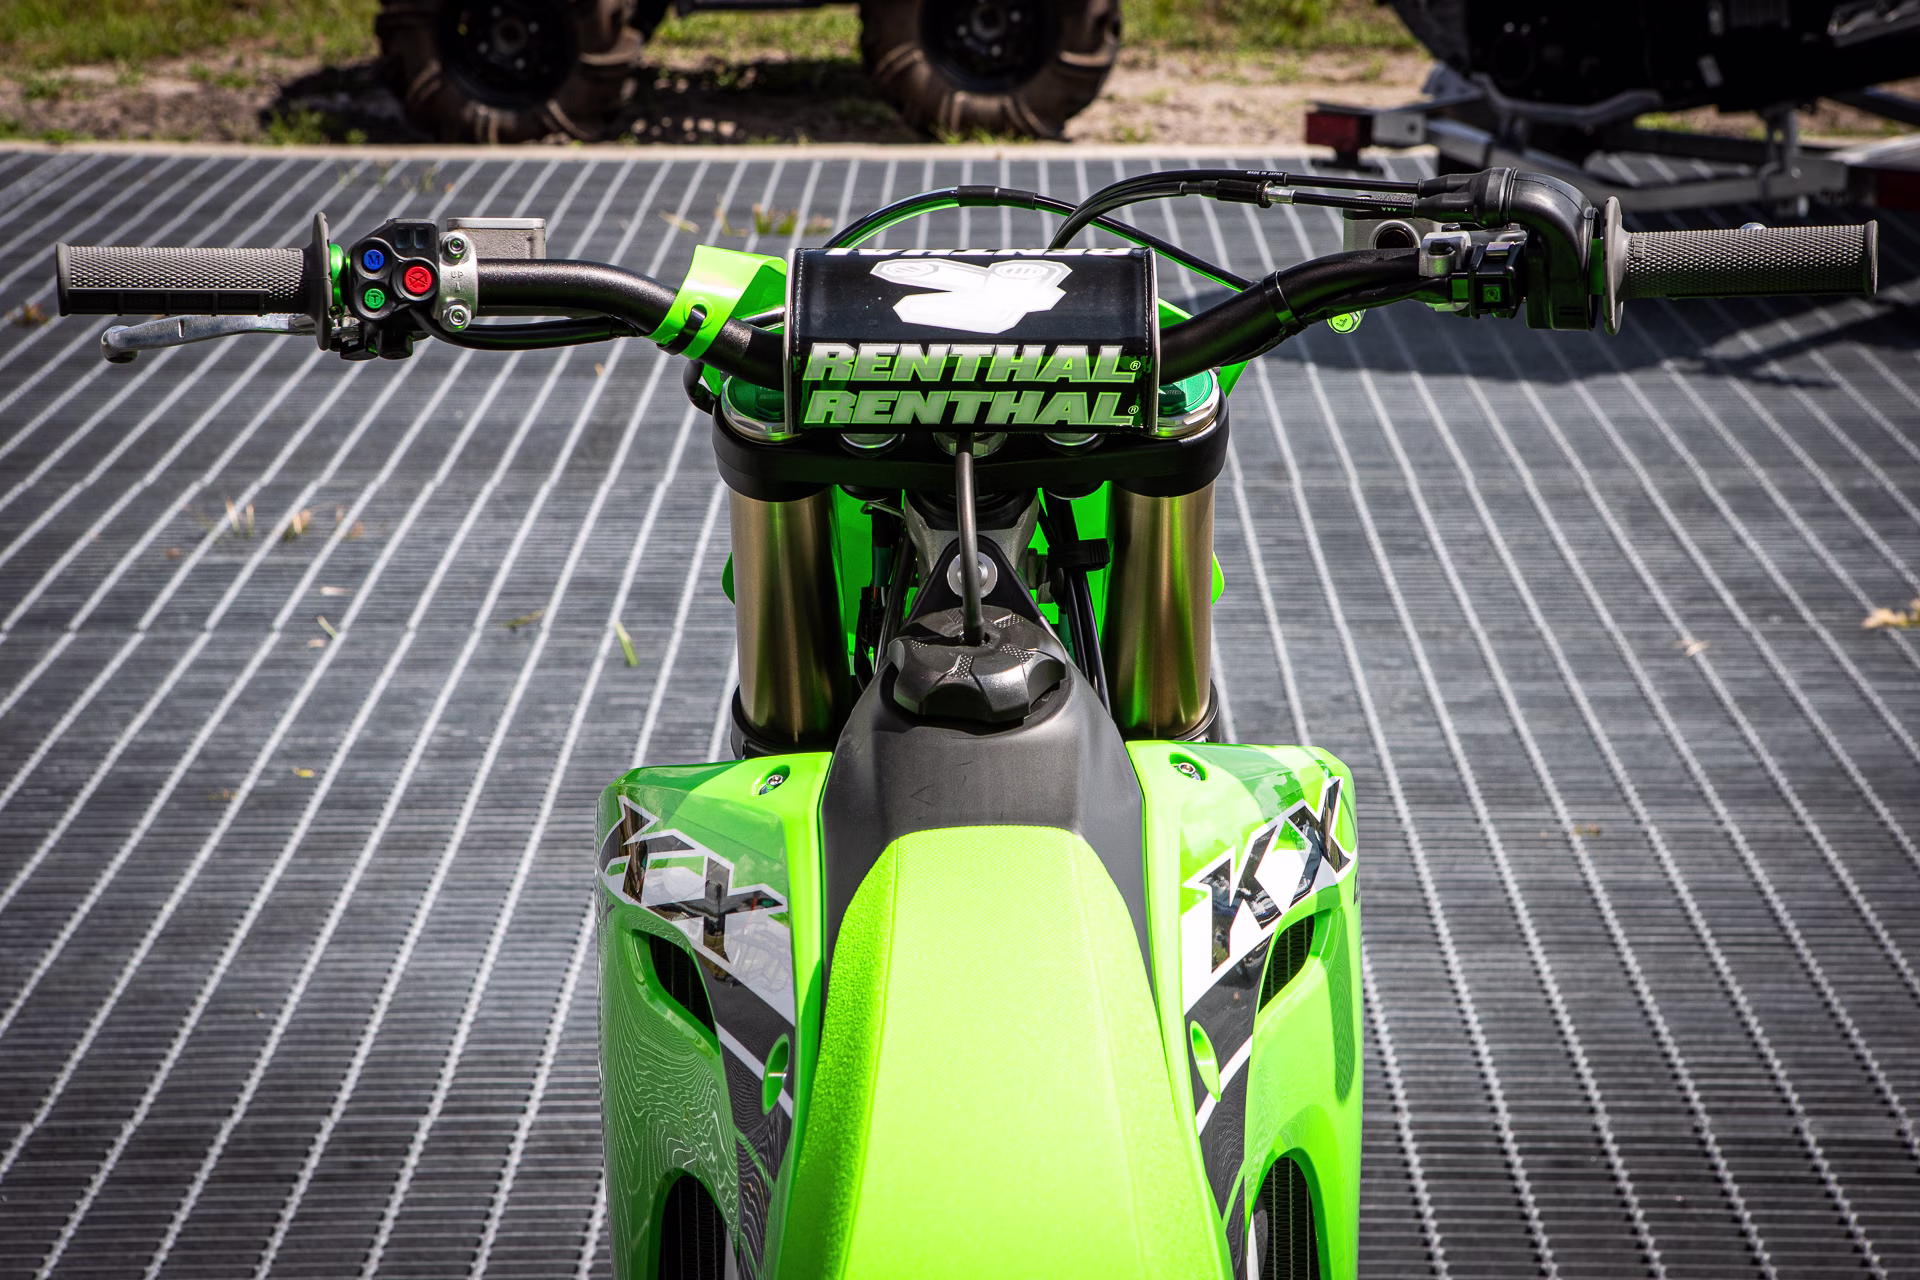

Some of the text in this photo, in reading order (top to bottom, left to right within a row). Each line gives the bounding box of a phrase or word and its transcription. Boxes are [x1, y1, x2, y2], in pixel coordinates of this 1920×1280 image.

[367, 253, 380, 266] M
[450, 270, 464, 279] UP
[803, 342, 1136, 383] RENTHAL
[803, 390, 1134, 426] RENTHAL
